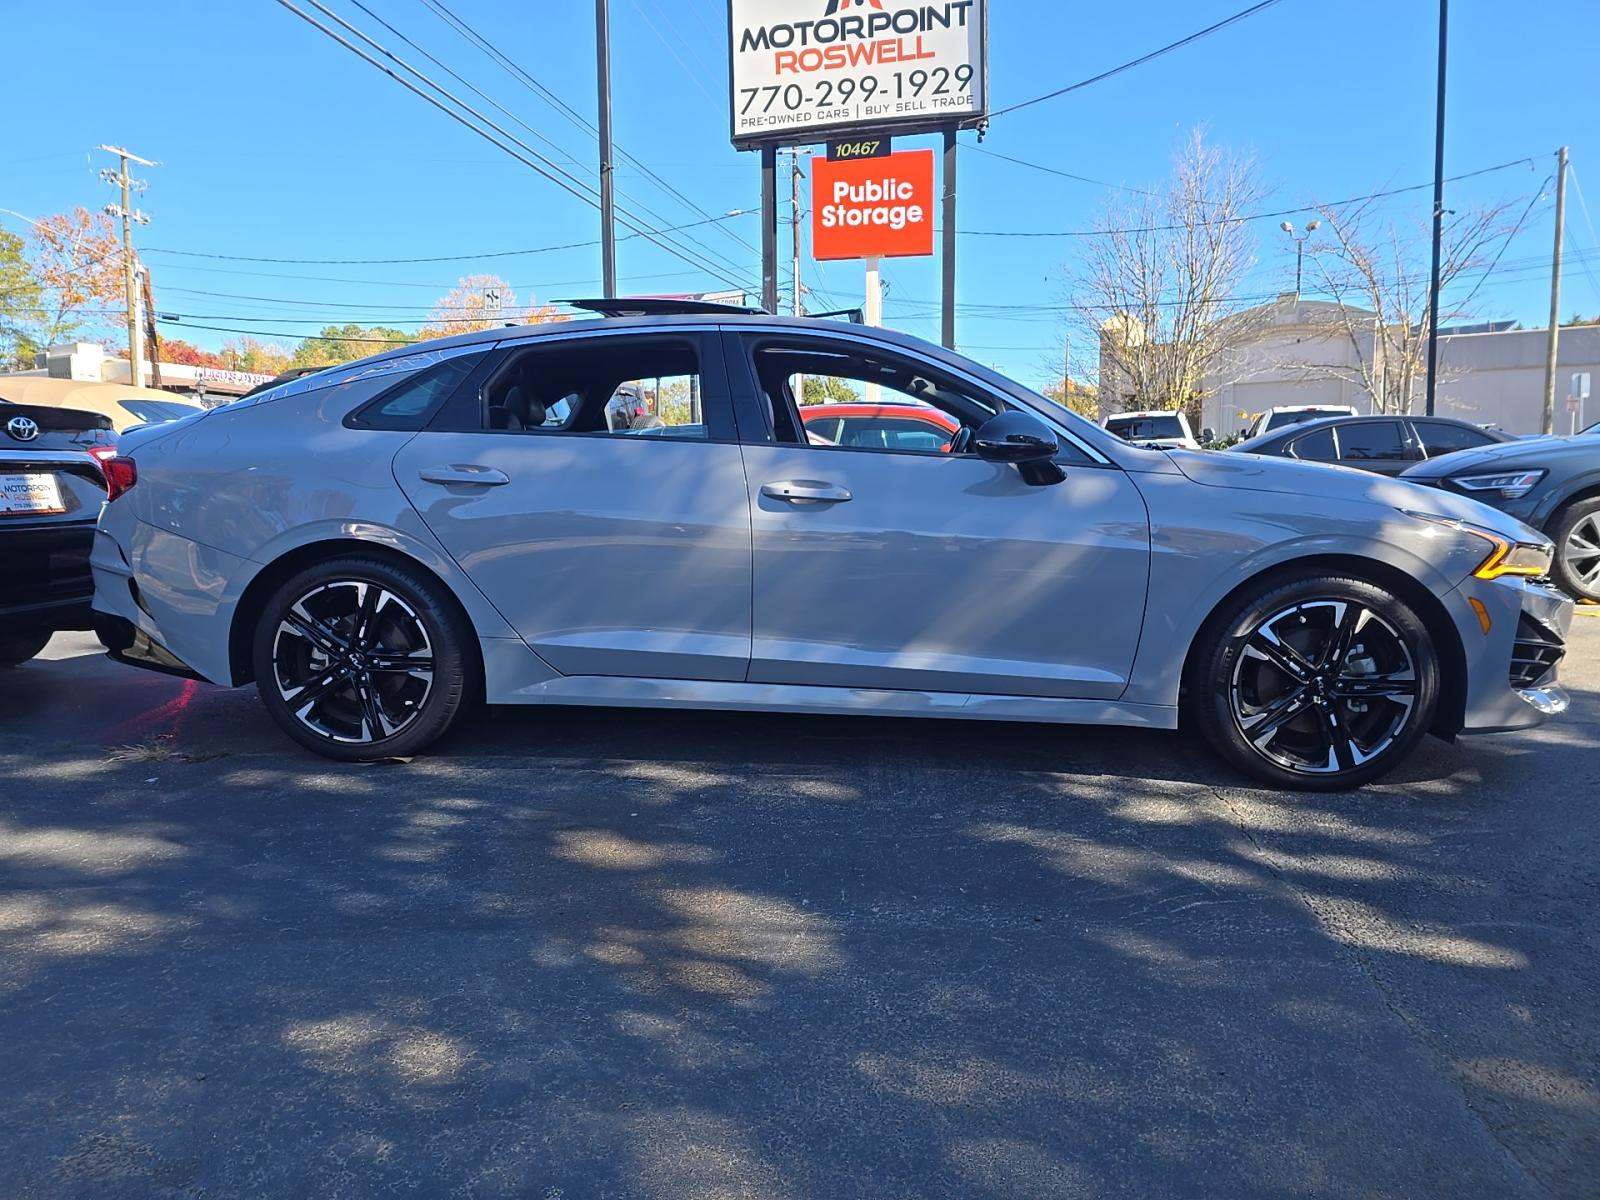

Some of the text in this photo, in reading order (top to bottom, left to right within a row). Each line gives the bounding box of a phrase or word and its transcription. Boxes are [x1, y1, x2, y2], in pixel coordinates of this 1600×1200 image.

[740, 0, 973, 52] MOTORPOINT
[775, 36, 935, 75] ROSWELL
[740, 63, 974, 115] 770-299-1929
[741, 94, 974, 128] PRE-OWNED CARS BUY SELL TRADE
[835, 140, 880, 158] 10467
[833, 179, 914, 204] Public
[821, 203, 923, 230] Storage
